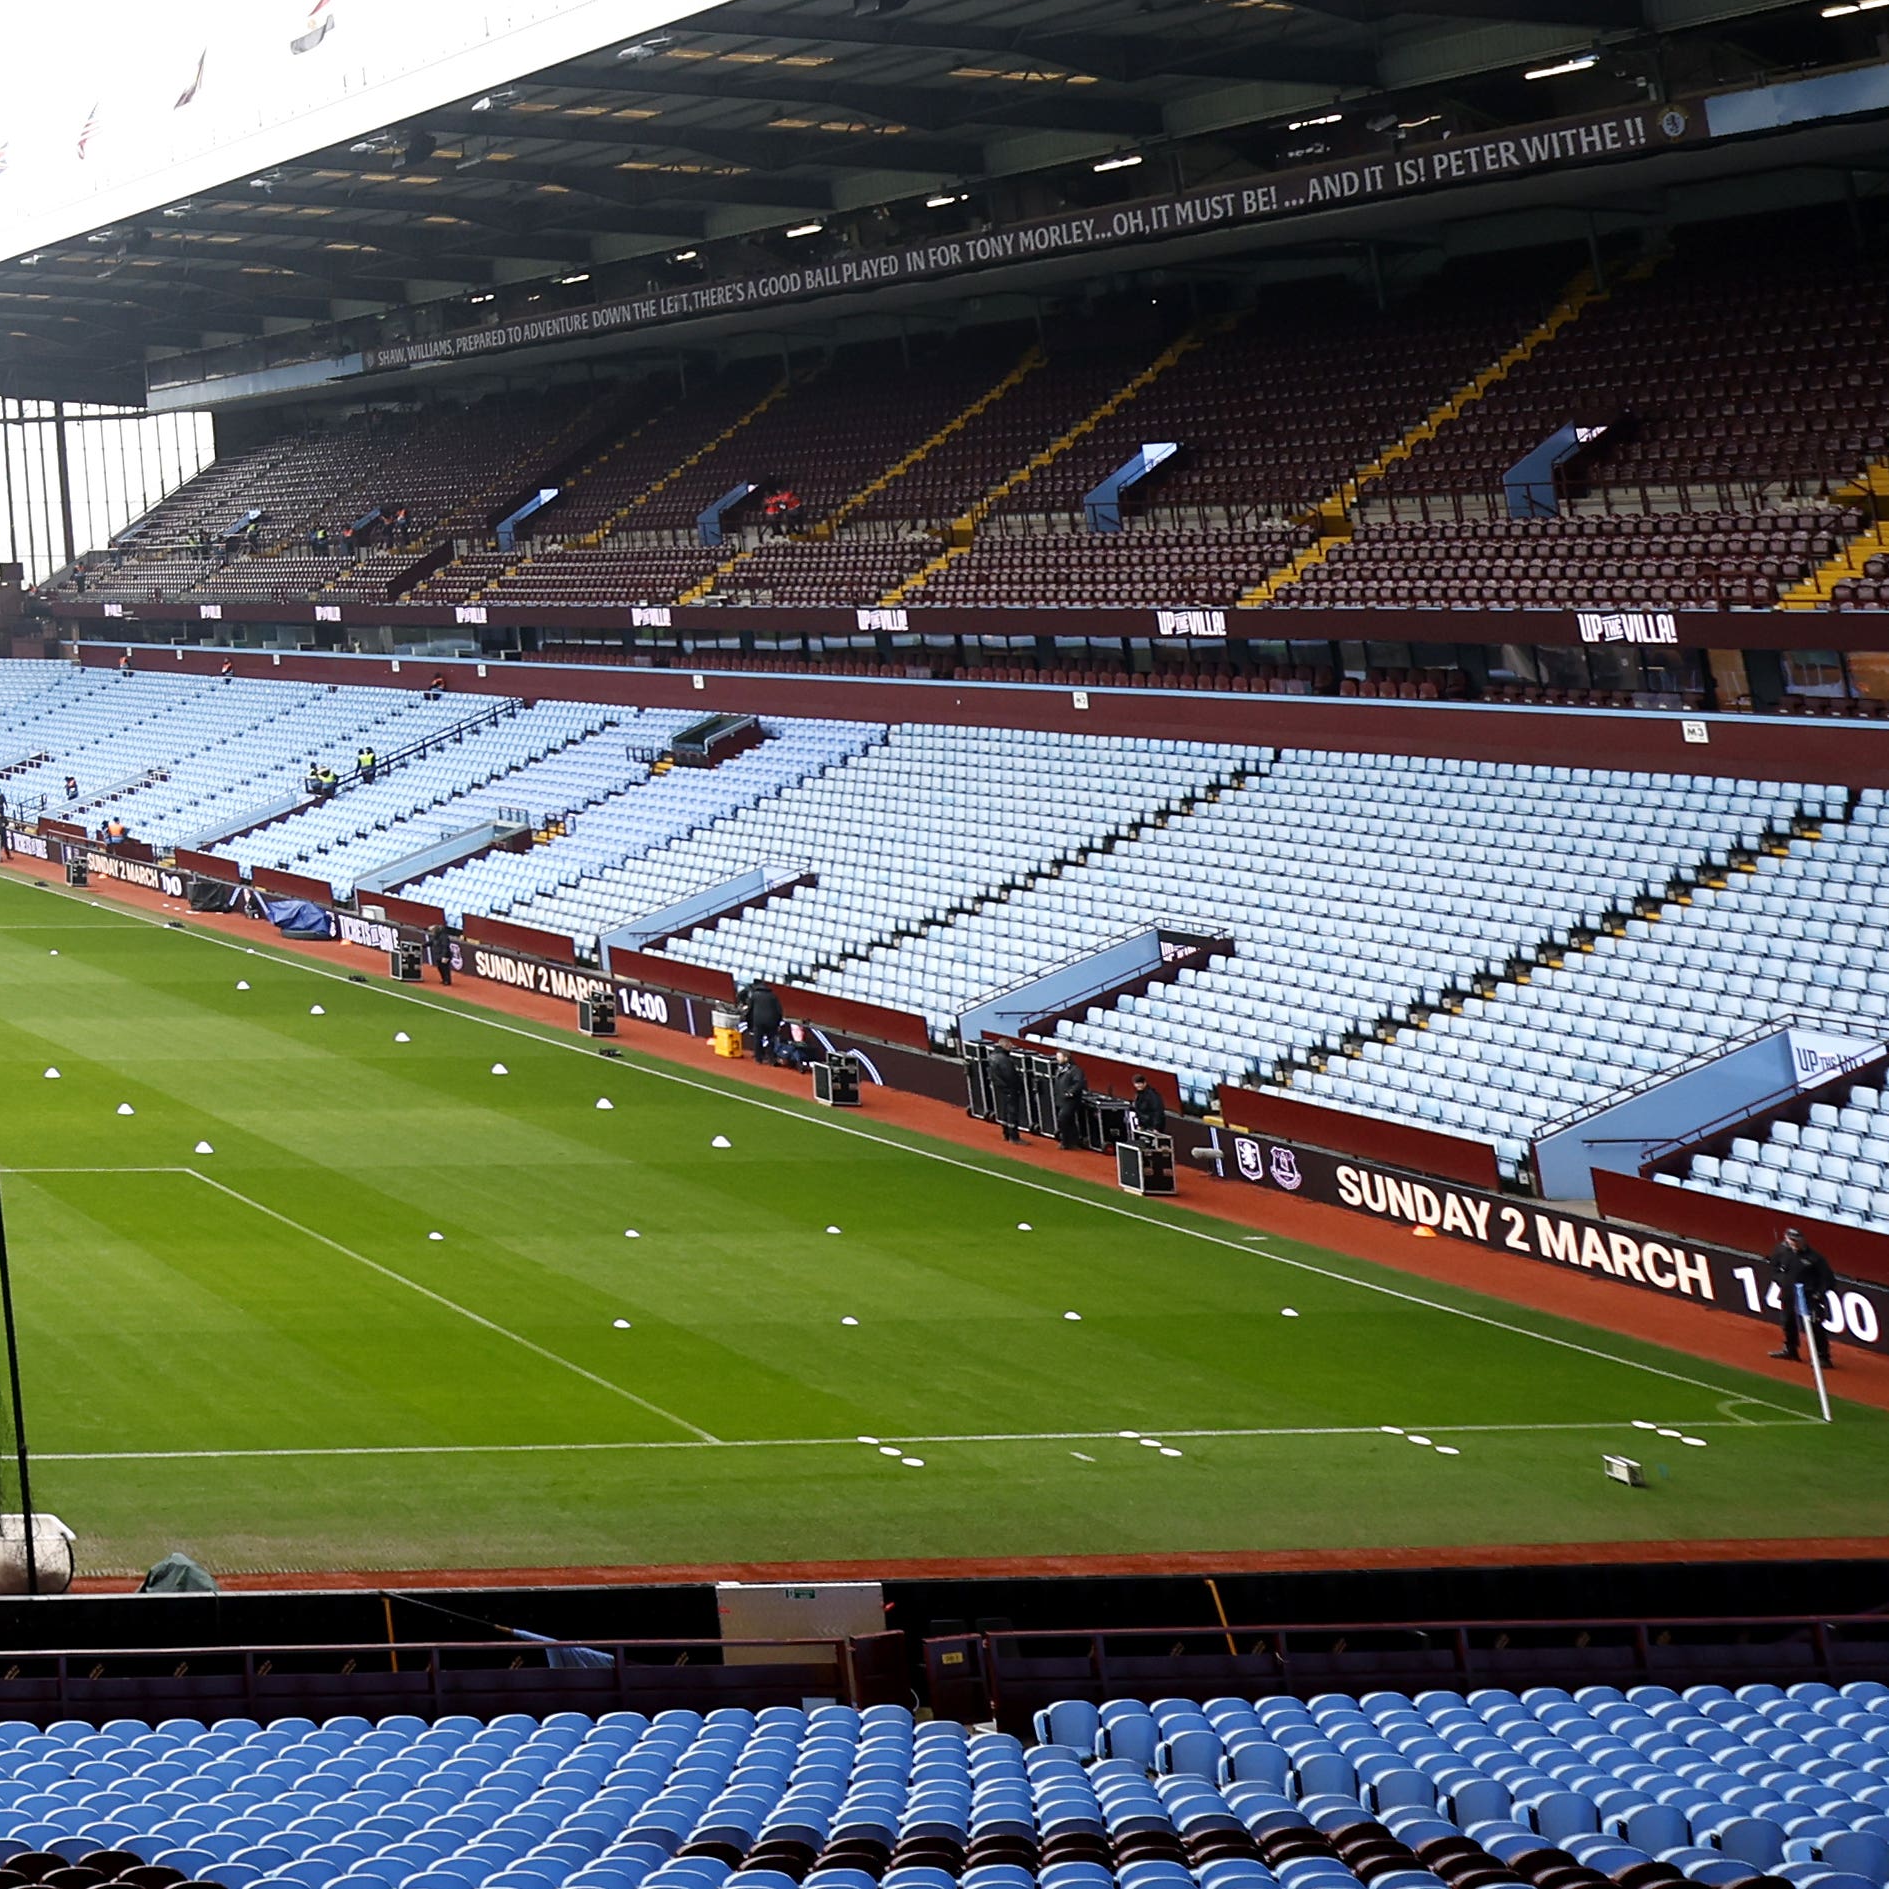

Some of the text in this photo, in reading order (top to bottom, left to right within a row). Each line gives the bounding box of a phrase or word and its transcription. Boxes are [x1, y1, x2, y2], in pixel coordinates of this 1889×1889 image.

[377, 346, 408, 367] SHAW,
[407, 338, 456, 362] WILLIAMS,
[456, 328, 507, 354] PREPARED
[506, 325, 523, 344] TO
[523, 313, 589, 341] ADVENTURE
[592, 304, 632, 329] DOWN
[631, 298, 657, 321] THE
[747, 281, 759, 300] A
[759, 273, 801, 298] GOOD
[805, 266, 841, 290] BALL
[843, 254, 899, 284] PLAYED
[906, 249, 925, 272] IN
[928, 243, 962, 270] FOR
[965, 233, 1014, 262] TONY
[1176, 193, 1235, 225] MUST
[1242, 185, 1277, 215] BE!
[1364, 164, 1385, 192] IT
[1395, 157, 1427, 187] IS!
[1432, 139, 1521, 180] PETER
[1521, 120, 1622, 165] WITHE
[1158, 611, 1174, 635] UP
[1187, 612, 1226, 636] VILLA!
[1577, 614, 1678, 644] UP THE VILLA!
[86, 853, 120, 880] SUNDAY
[126, 863, 160, 889] MARCH
[475, 950, 536, 990] SUNDAY
[539, 966, 551, 994] 2
[618, 986, 669, 1025] 14:00
[1795, 1046, 1819, 1073] UP
[1335, 1164, 1493, 1242] SUNDAY
[1500, 1207, 1532, 1253] 2
[1534, 1214, 1717, 1301] MARCH
